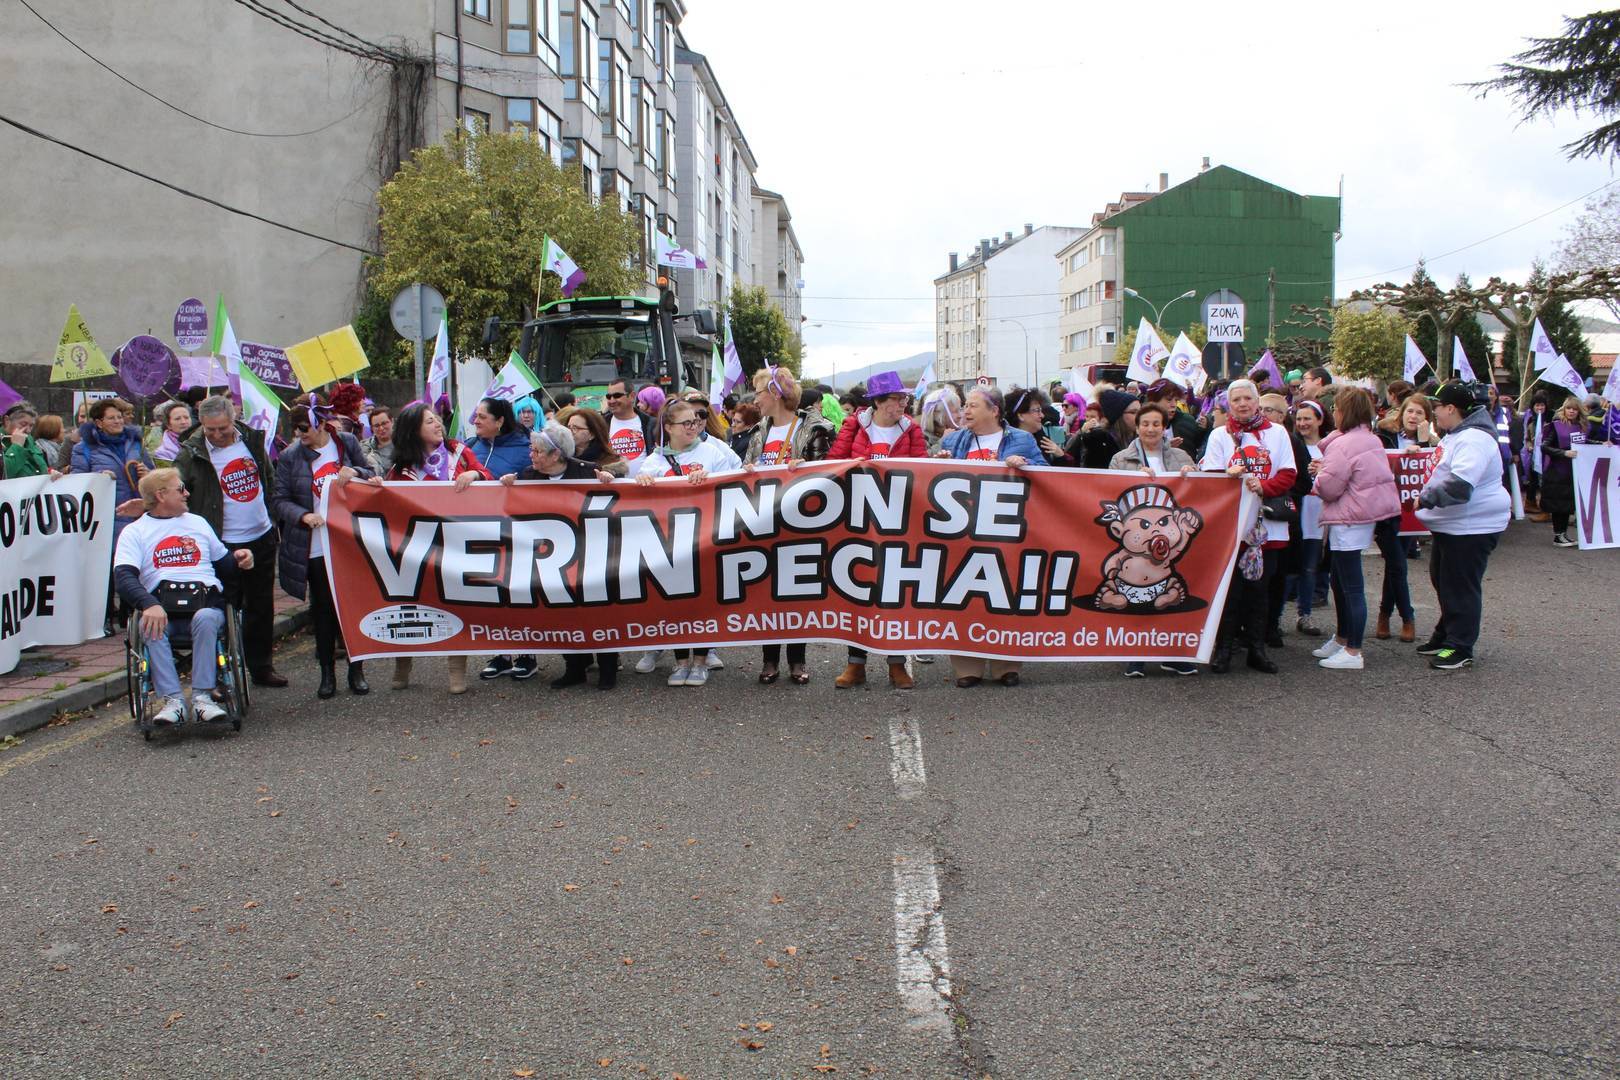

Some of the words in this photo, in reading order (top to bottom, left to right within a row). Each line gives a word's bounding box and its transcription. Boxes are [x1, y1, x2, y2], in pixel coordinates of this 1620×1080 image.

[1210, 307, 1239, 318] ZONA
[227, 478, 246, 489] NON
[246, 475, 255, 483] SE
[716, 472, 908, 541] NON
[928, 476, 1026, 539] SE
[354, 494, 698, 605] VERÍN
[721, 542, 1075, 611] PECHA!!
[469, 623, 586, 643] Plataforma
[592, 628, 621, 642] en
[626, 618, 719, 639] Defensa
[726, 610, 852, 633] SANIDADE
[857, 614, 960, 641] PÚBLICA
[967, 622, 1066, 647] Comarca
[1072, 626, 1099, 647] de
